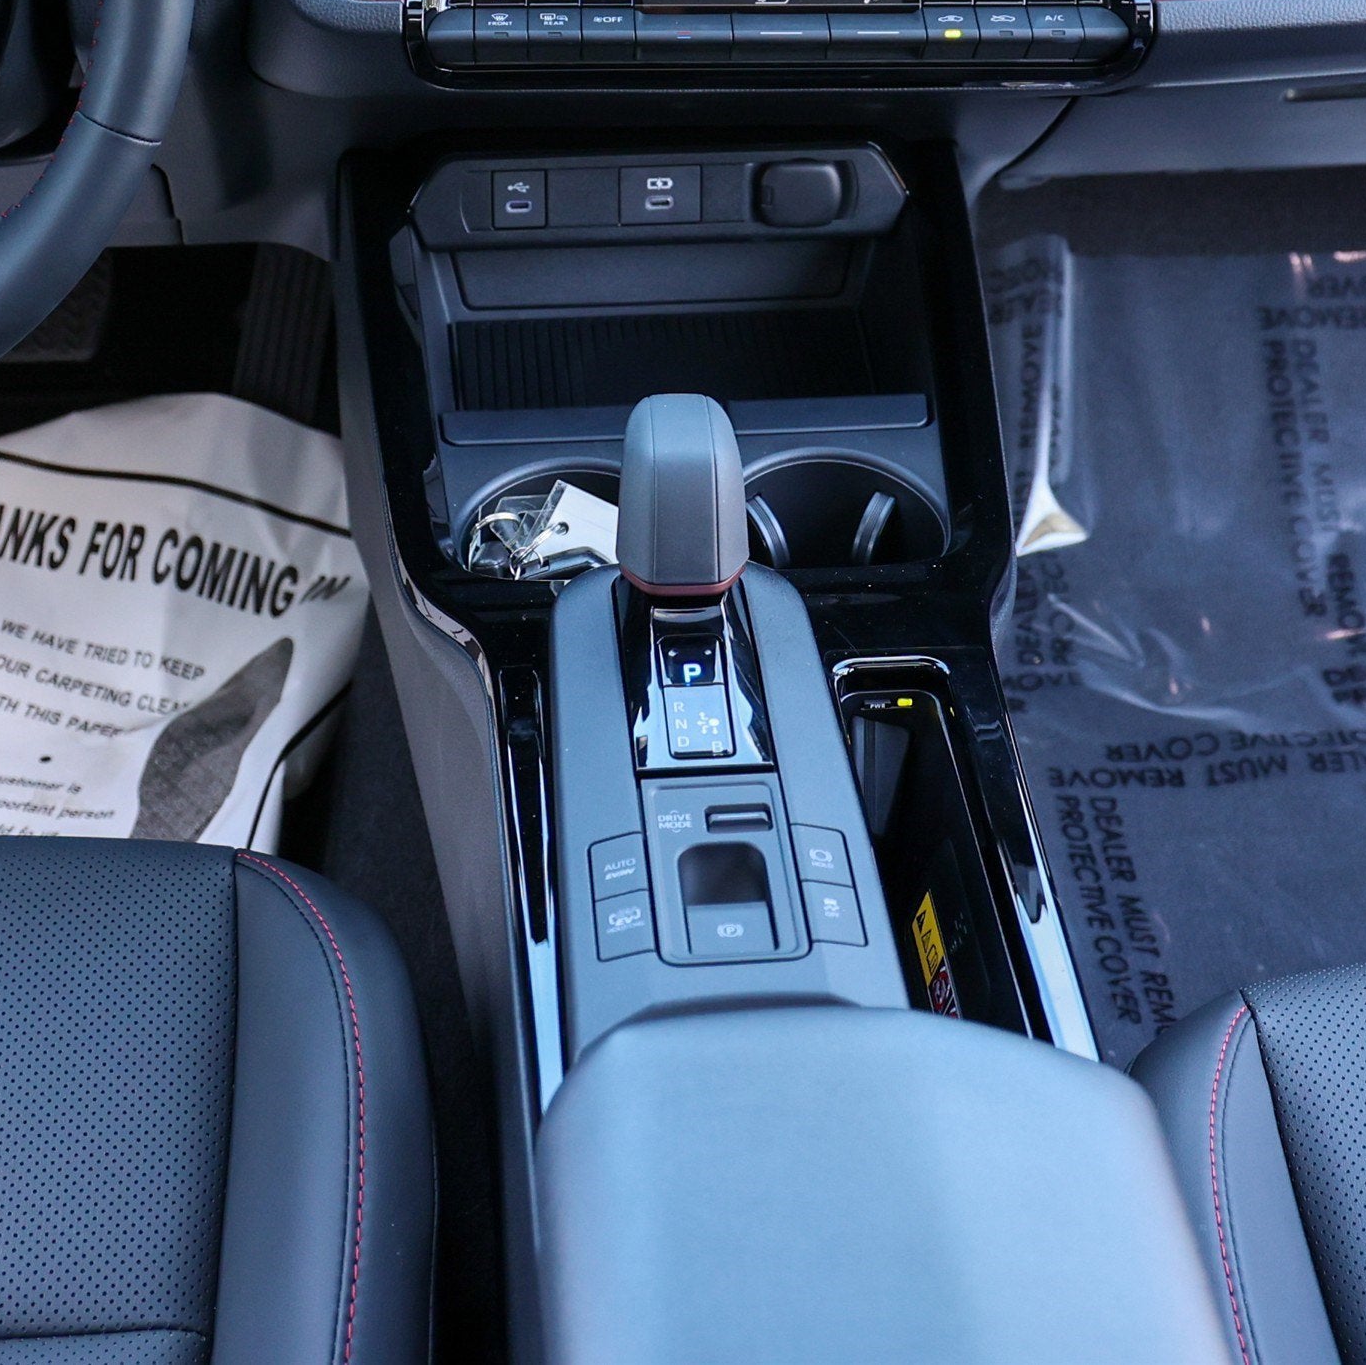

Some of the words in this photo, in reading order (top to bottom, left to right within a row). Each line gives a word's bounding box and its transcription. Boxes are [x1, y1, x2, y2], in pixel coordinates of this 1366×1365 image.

[602, 15, 623, 24] OFF
[1044, 13, 1065, 22] A/C
[1293, 338, 1331, 445] DEALER
[1262, 338, 1308, 508] PROTECTIVE
[78, 520, 147, 583] FOR
[153, 527, 301, 619] COMING
[299, 574, 352, 605] IN
[0, 618, 29, 640] WE
[31, 629, 81, 656] HAVE
[83, 642, 131, 667] TRIED
[133, 649, 155, 669] TO
[158, 654, 208, 682] KEEP
[682, 662, 702, 686] P
[34, 666, 133, 708] CARPETING
[673, 701, 685, 713] R
[23, 703, 64, 726] THIS
[65, 717, 126, 739] PAPER
[675, 718, 688, 730] N
[677, 736, 690, 748] D
[711, 740, 724, 753] B
[1105, 733, 1221, 763] COVER
[1047, 765, 1187, 789] REMOVE
[1204, 754, 1289, 788] MUST
[65, 782, 83, 795] is
[55, 807, 116, 821] person
[657, 813, 693, 823] DRIVE
[657, 821, 693, 830] MODE
[603, 858, 637, 872] AUTO
[1088, 794, 1138, 883] DEALER
[1116, 892, 1161, 959] MUST
[1055, 793, 1116, 932] PROTECTIVE
[1092, 934, 1143, 1026] COVER
